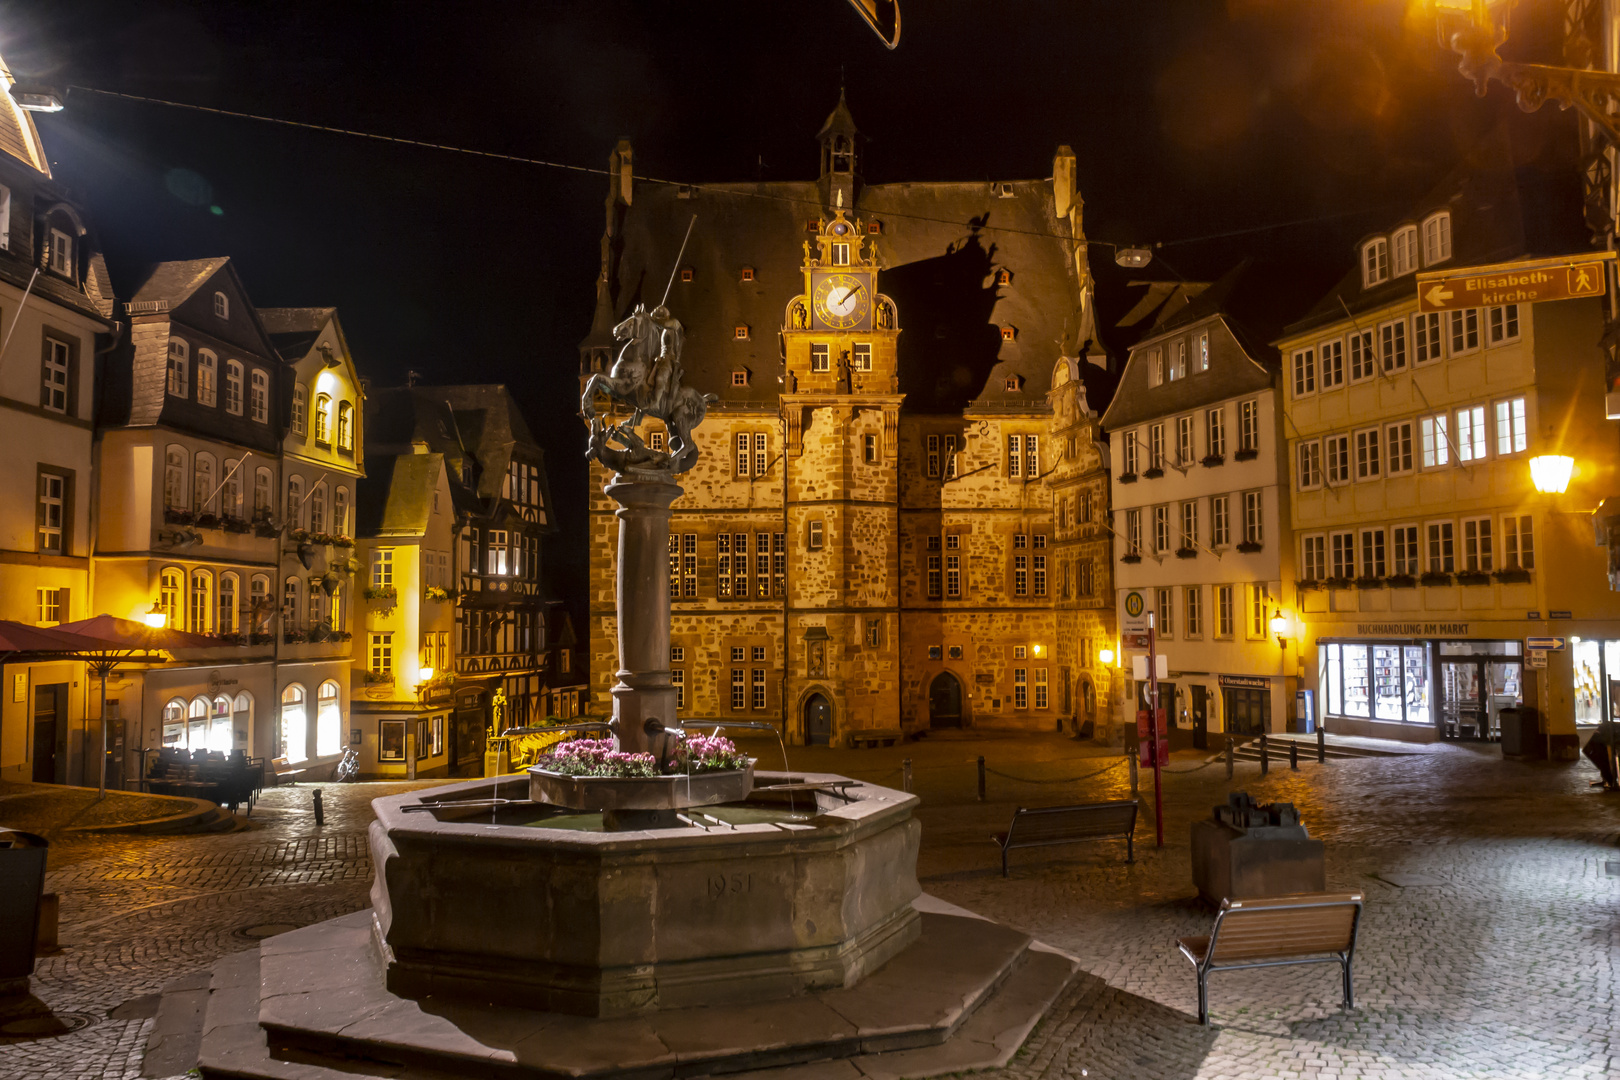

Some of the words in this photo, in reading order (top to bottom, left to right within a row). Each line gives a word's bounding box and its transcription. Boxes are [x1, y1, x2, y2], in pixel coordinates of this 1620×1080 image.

[1465, 271, 1554, 291] Elisabeth-
[1482, 289, 1538, 305] kirche
[1357, 624, 1421, 635] BUCHHANDLUNG
[1424, 624, 1437, 635] AM
[1439, 624, 1469, 635] MARKT
[707, 873, 752, 899] 1951
